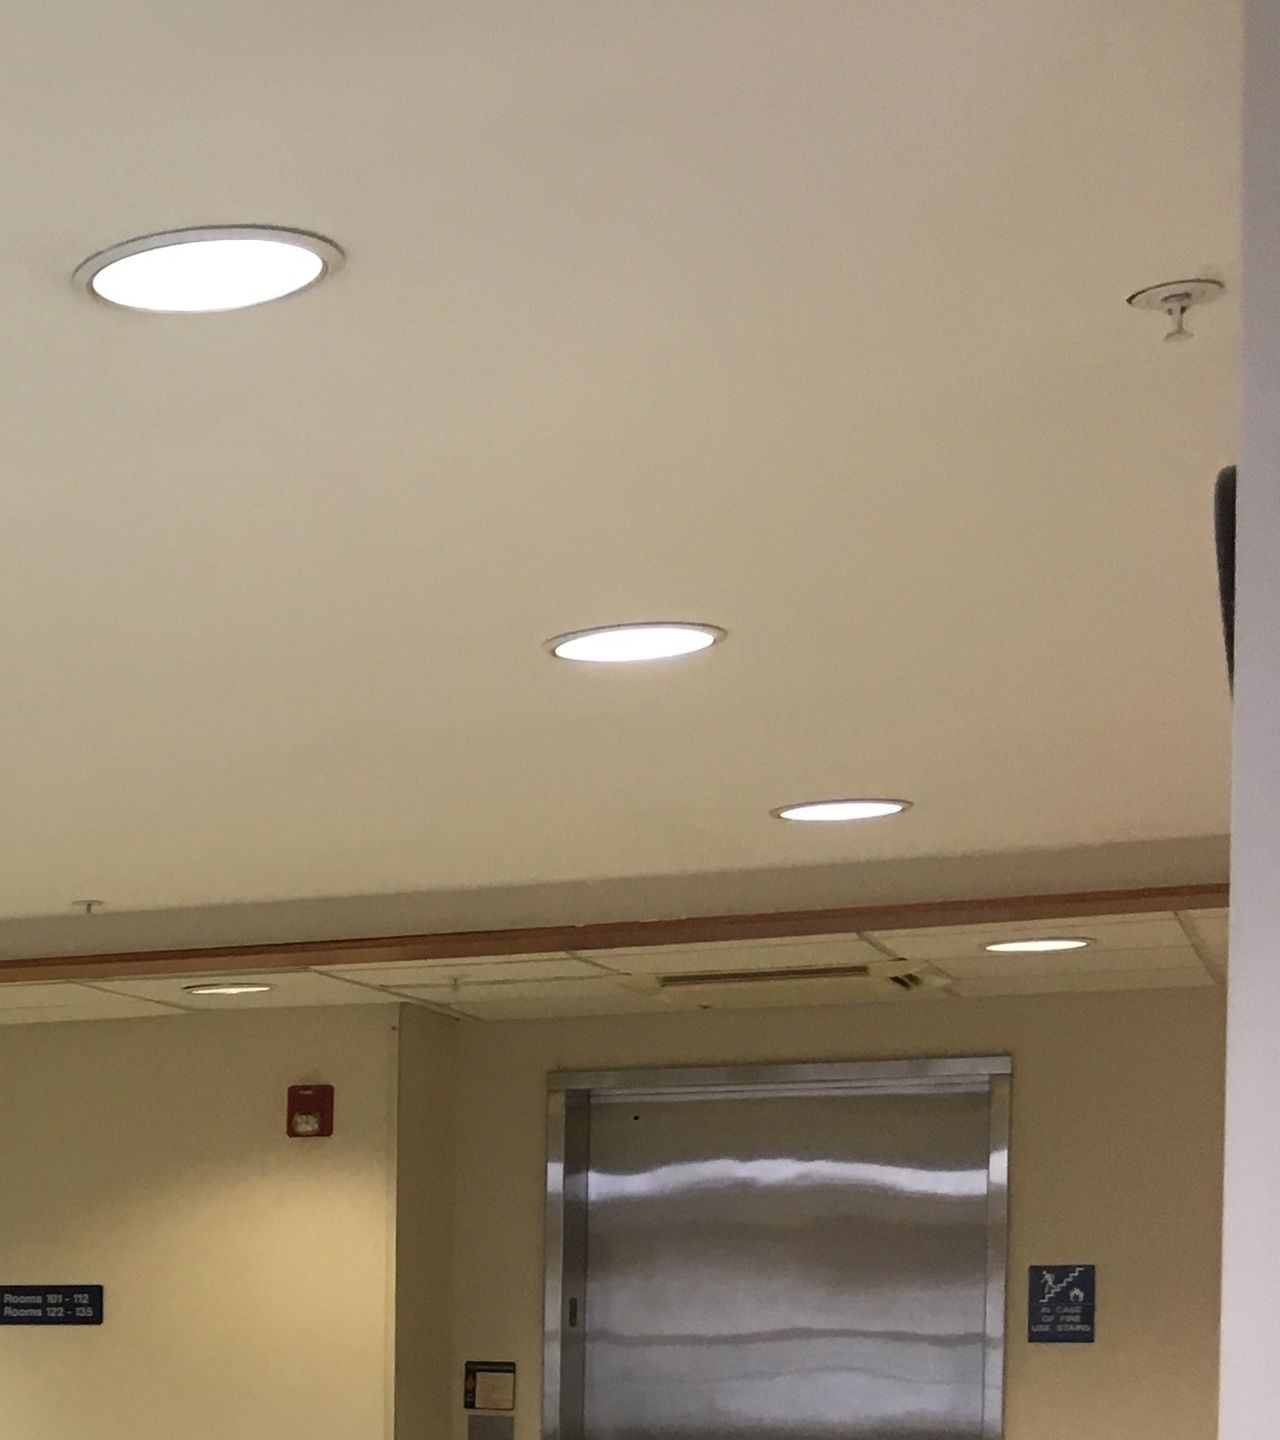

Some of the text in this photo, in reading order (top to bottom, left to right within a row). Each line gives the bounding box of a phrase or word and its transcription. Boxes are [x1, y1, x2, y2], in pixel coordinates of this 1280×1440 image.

[3, 1293, 43, 1304] Rooms
[73, 1293, 89, 1304] 112
[3, 1306, 43, 1317] Rooms
[46, 1307, 64, 1317] 122
